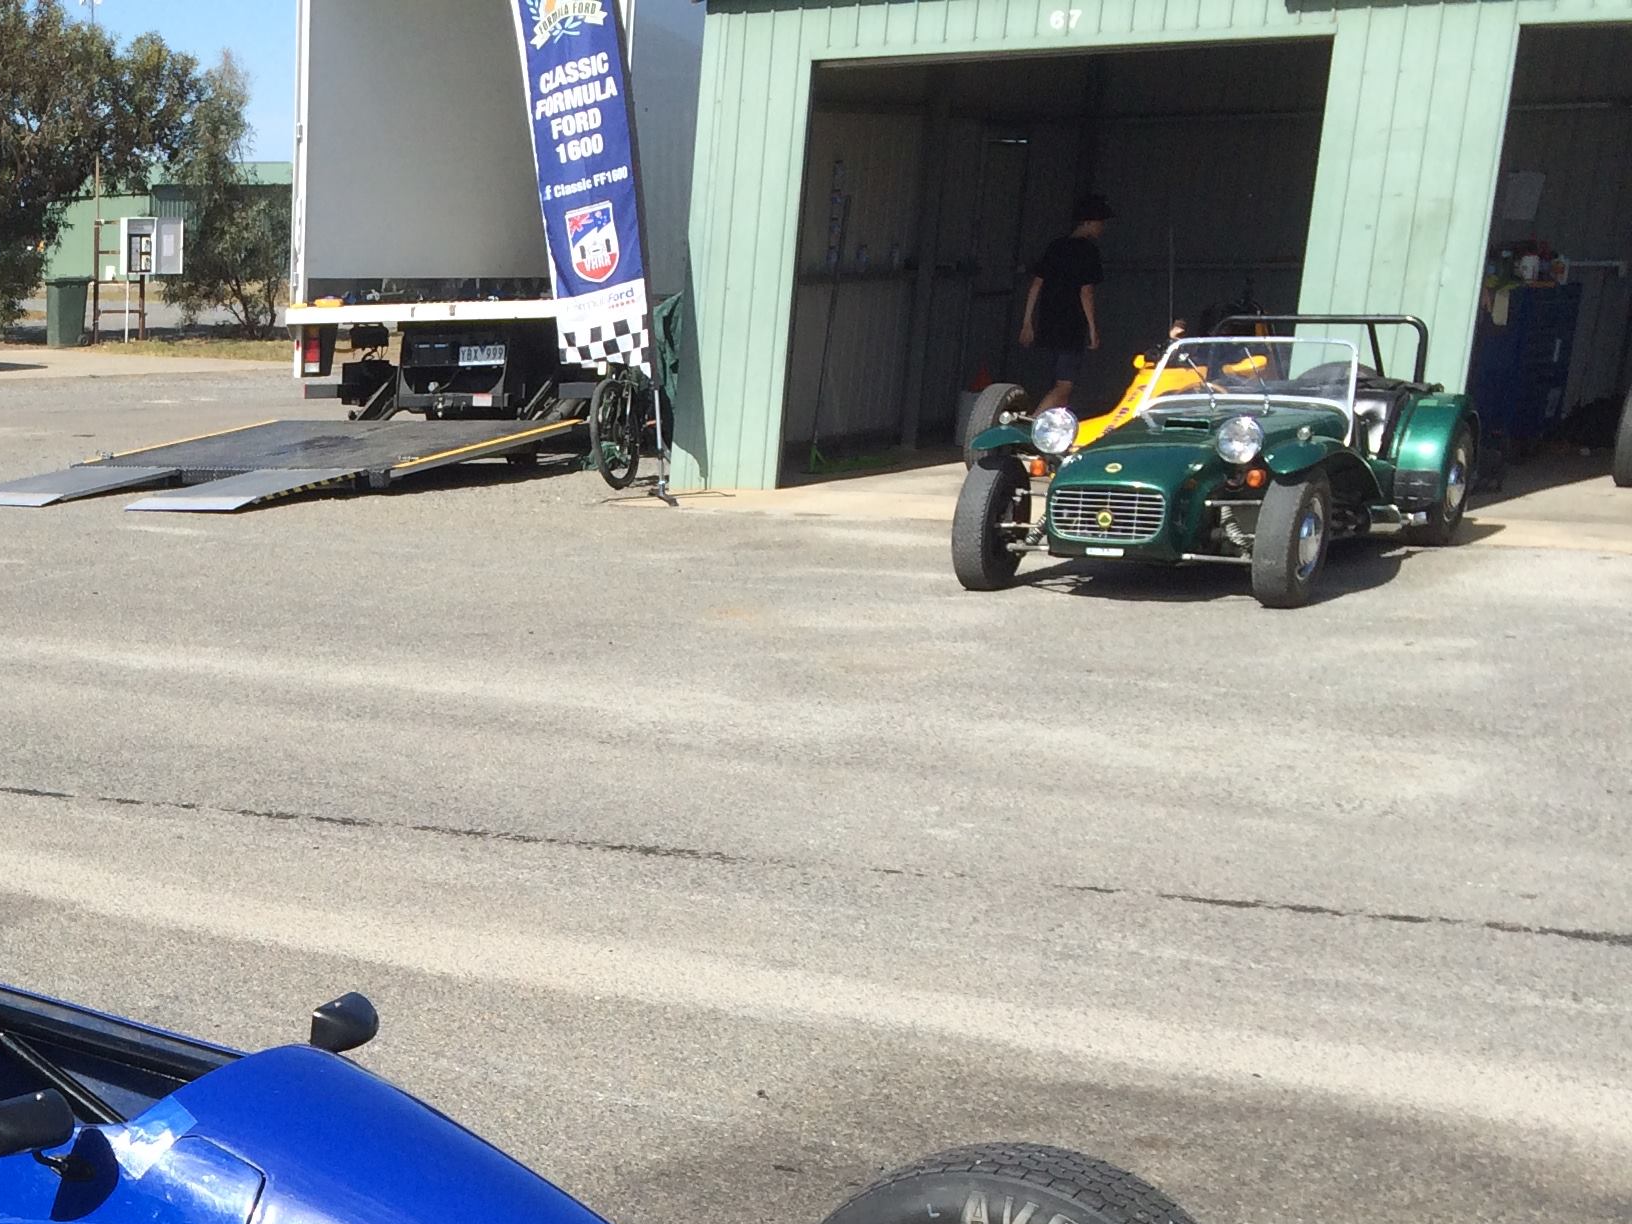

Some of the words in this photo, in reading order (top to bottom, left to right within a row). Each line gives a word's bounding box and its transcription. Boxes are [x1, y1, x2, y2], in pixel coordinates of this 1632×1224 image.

[572, 2, 597, 15] FORD
[1049, 9, 1083, 29] 67
[539, 52, 609, 94] CLASSIC
[535, 76, 618, 120] FORMULA
[550, 107, 602, 140] FORD
[555, 133, 604, 164] 1600
[553, 178, 593, 199] Classic
[593, 165, 629, 187] FF1600
